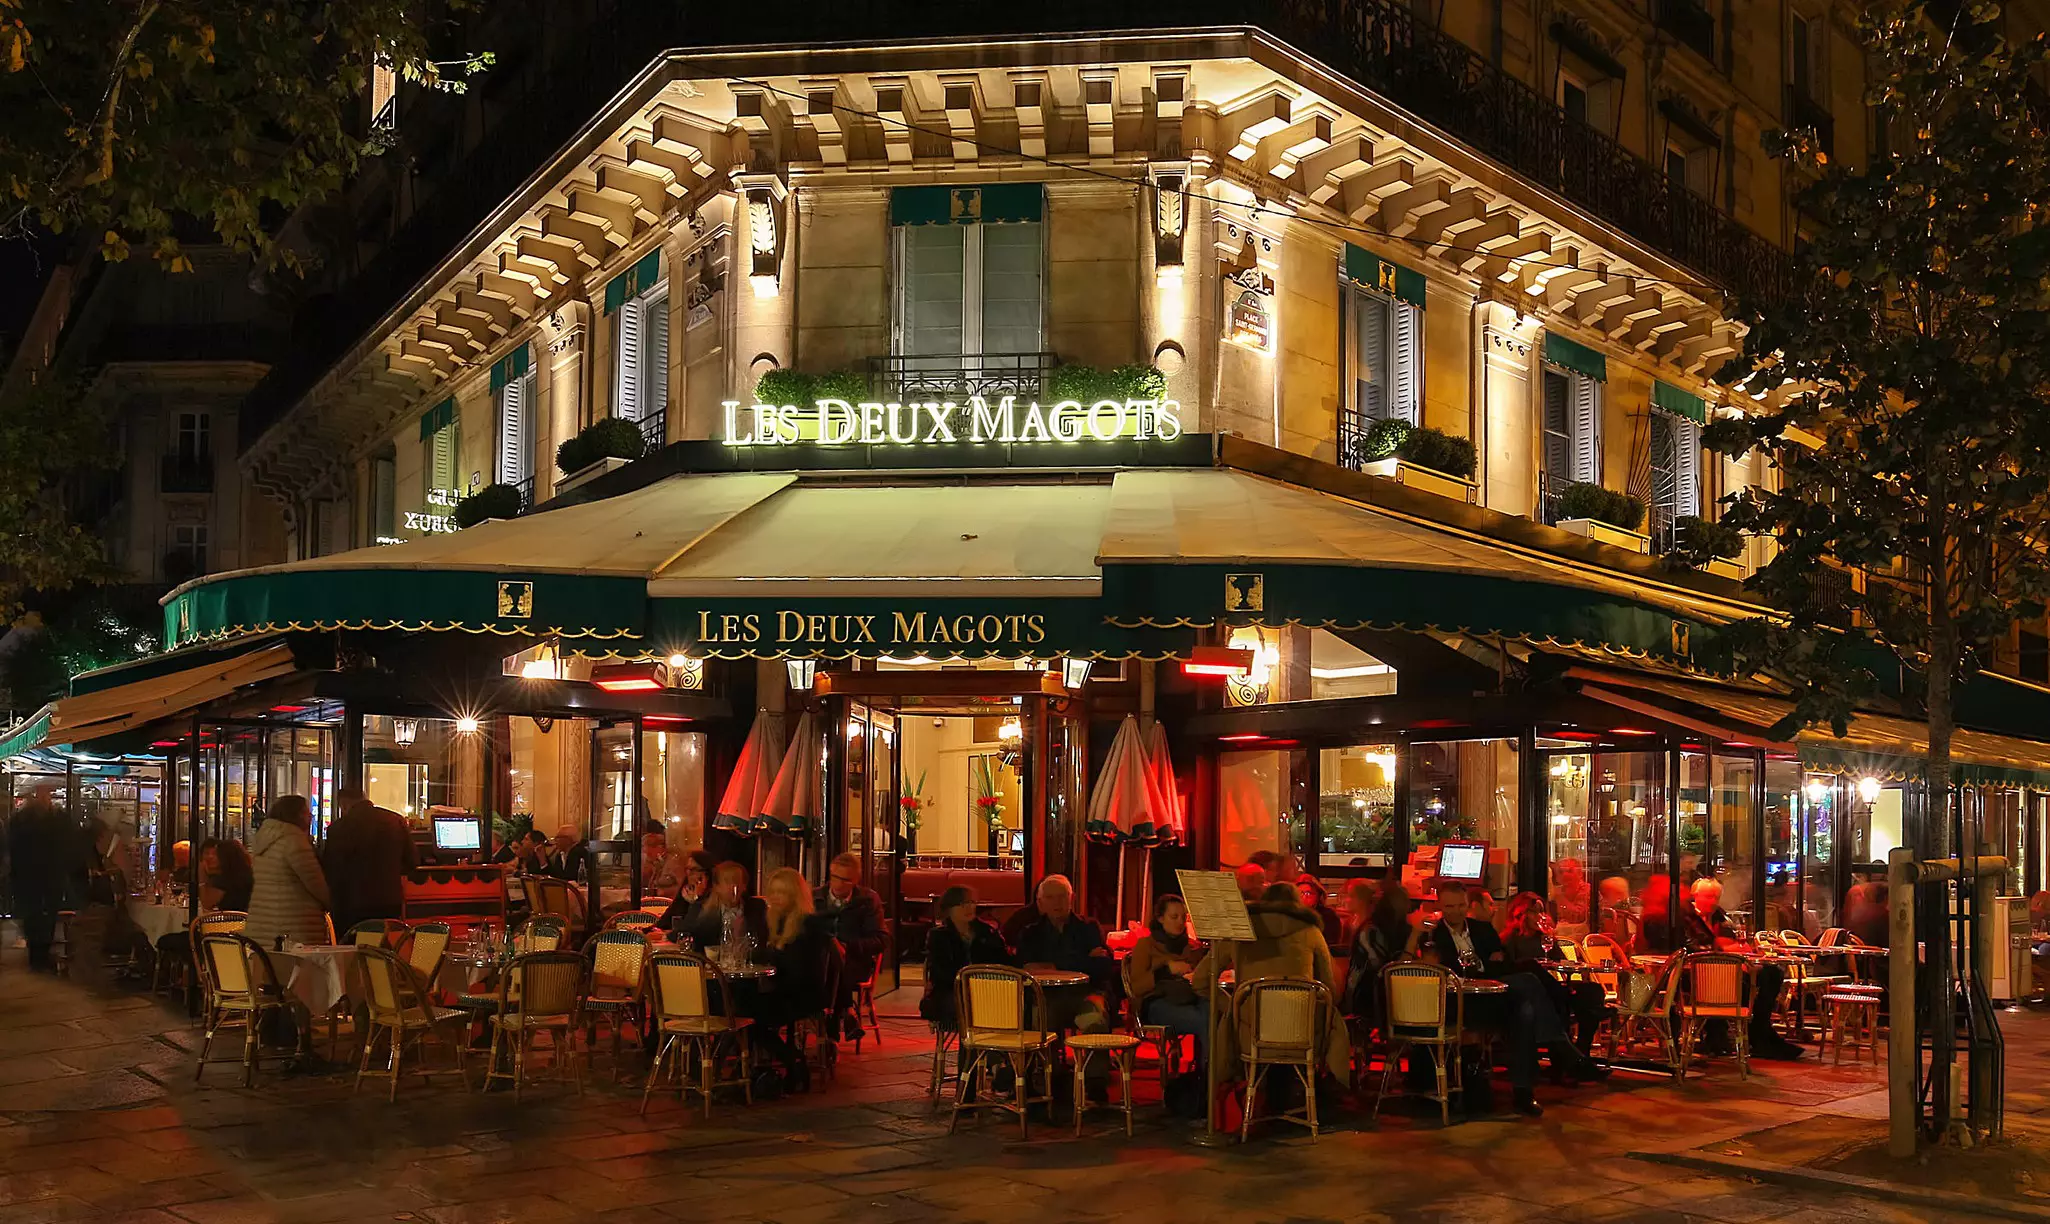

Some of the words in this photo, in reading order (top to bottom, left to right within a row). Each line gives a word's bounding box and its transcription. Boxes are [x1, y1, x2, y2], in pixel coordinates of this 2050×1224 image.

[721, 400, 801, 446] LES
[815, 399, 957, 444] DEUX
[969, 395, 1181, 443] MAGOTS
[697, 610, 761, 643] LES
[776, 610, 876, 643] DEUX
[891, 611, 1045, 643] MAGOTS
